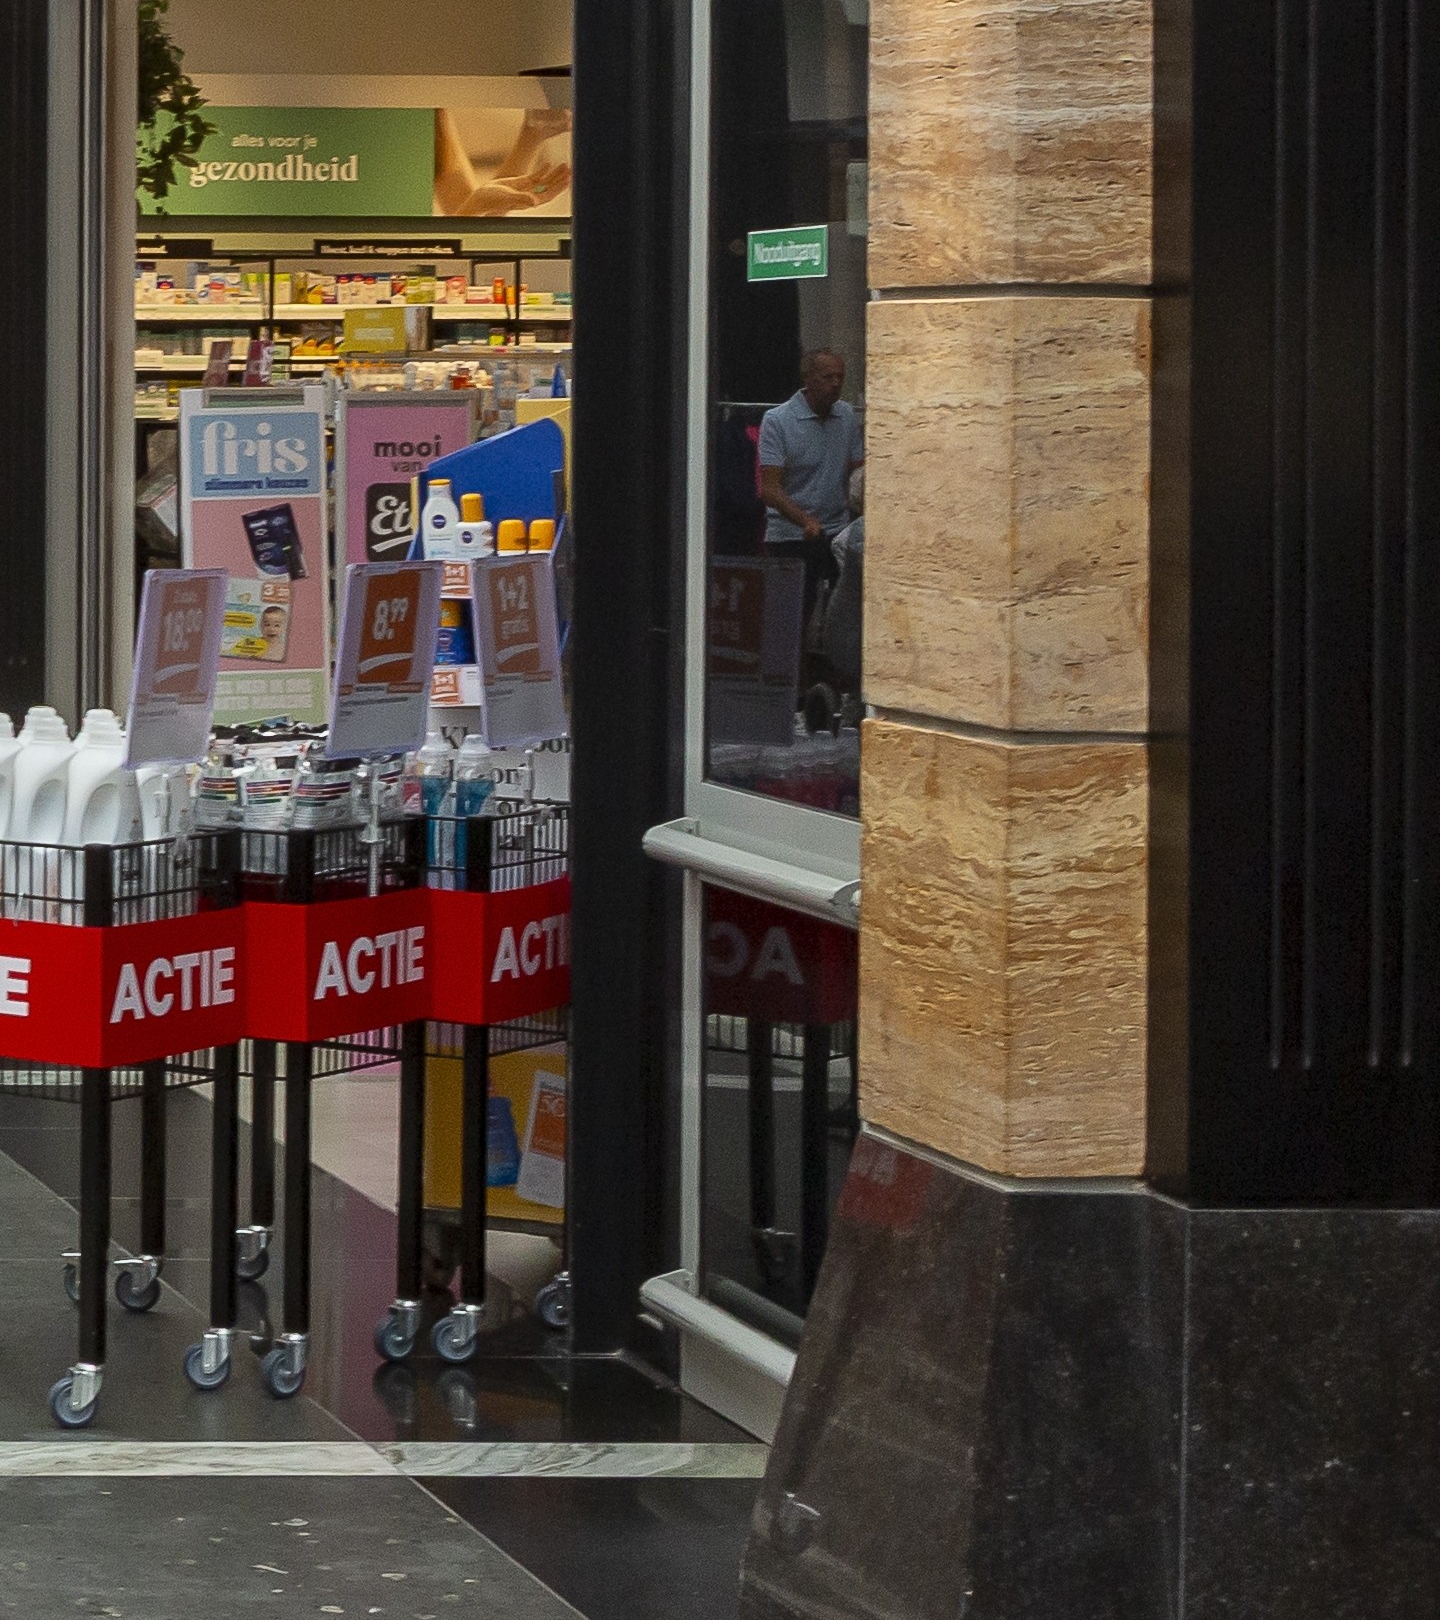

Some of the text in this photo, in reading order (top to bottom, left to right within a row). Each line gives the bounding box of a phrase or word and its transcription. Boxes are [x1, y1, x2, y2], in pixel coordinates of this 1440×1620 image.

[231, 134, 264, 147] alles
[268, 137, 301, 147] voor
[189, 154, 359, 187] gezondheid
[200, 421, 310, 476] fris
[374, 434, 442, 457] mooi
[391, 461, 422, 472] van
[370, 495, 411, 536] Et
[314, 925, 426, 1001] ACTIE
[491, 912, 570, 982] ACTI
[110, 946, 236, 1025] ACTIE
